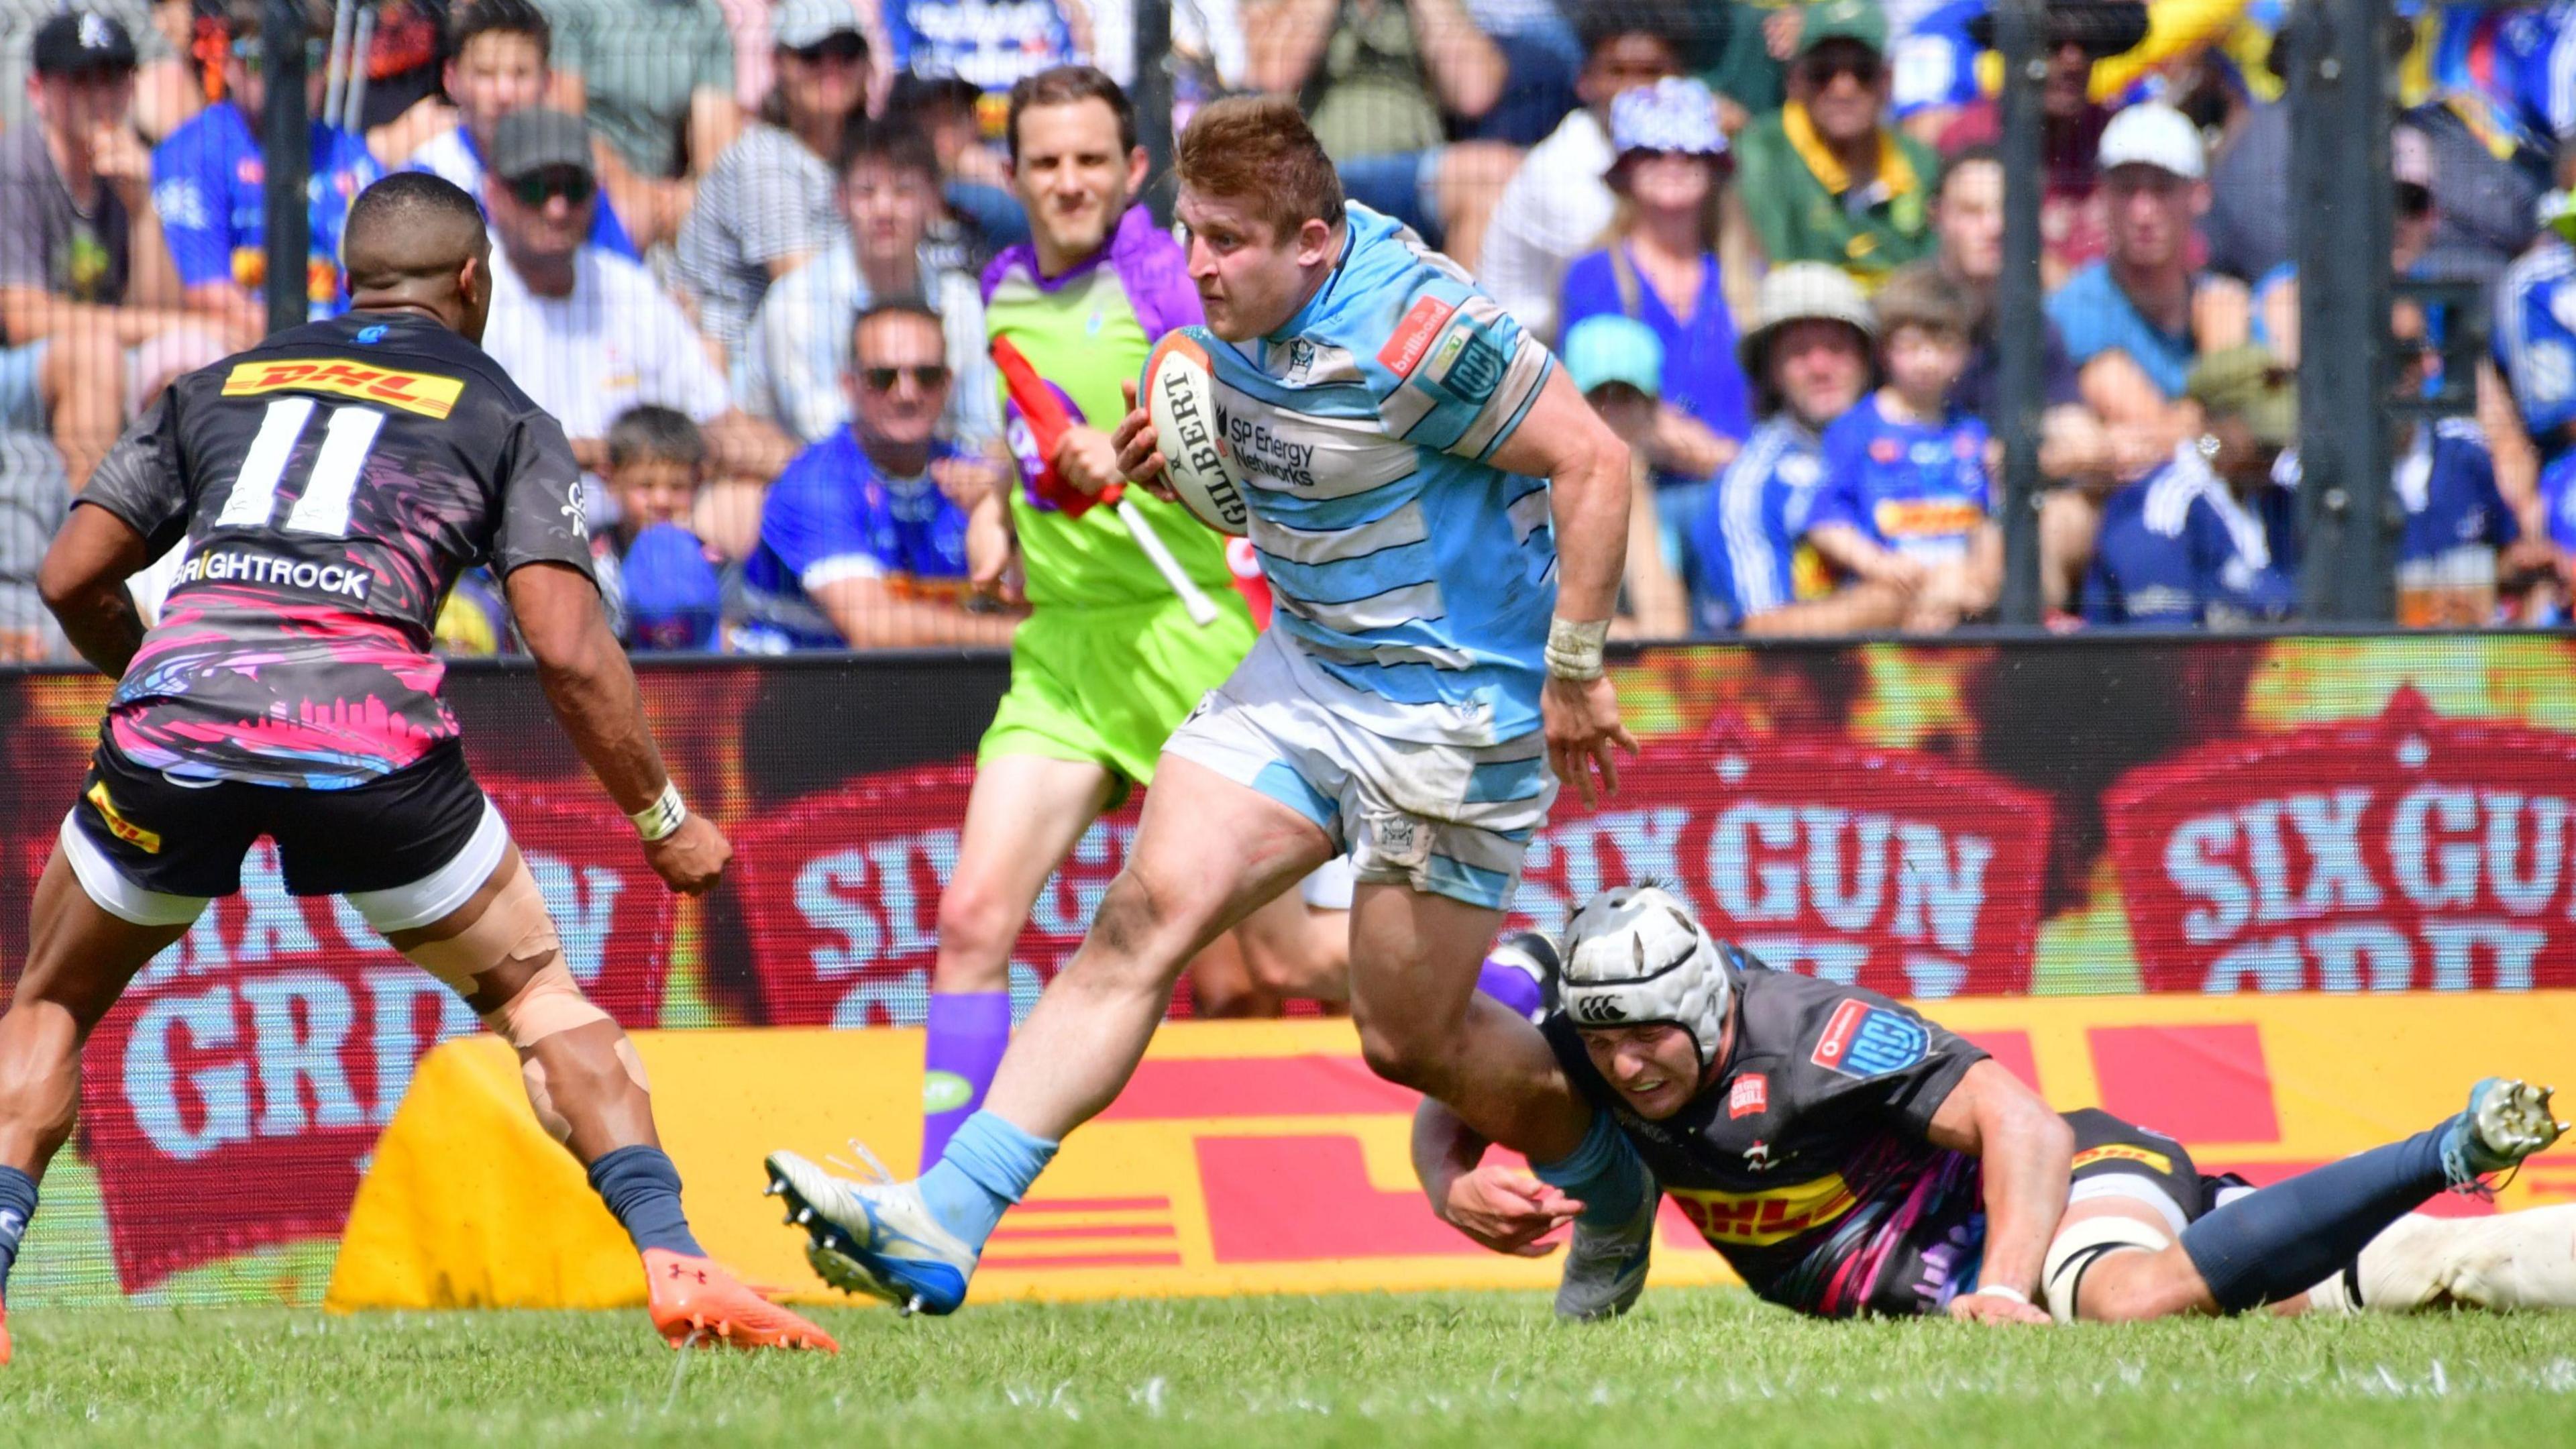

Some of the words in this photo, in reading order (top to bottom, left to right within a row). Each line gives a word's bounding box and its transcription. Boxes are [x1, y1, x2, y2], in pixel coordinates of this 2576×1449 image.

[253, 365, 421, 402] DHL
[1390, 301, 1449, 373] brillband
[214, 397, 386, 539] 11
[1163, 369, 1248, 526] GILBERT
[1230, 417, 1252, 445] SP
[1255, 425, 1314, 469] Energy
[1232, 443, 1316, 488] Networks
[1706, 802, 1998, 956] GUN
[2163, 786, 2385, 945] SIX
[2388, 781, 2576, 923] GU
